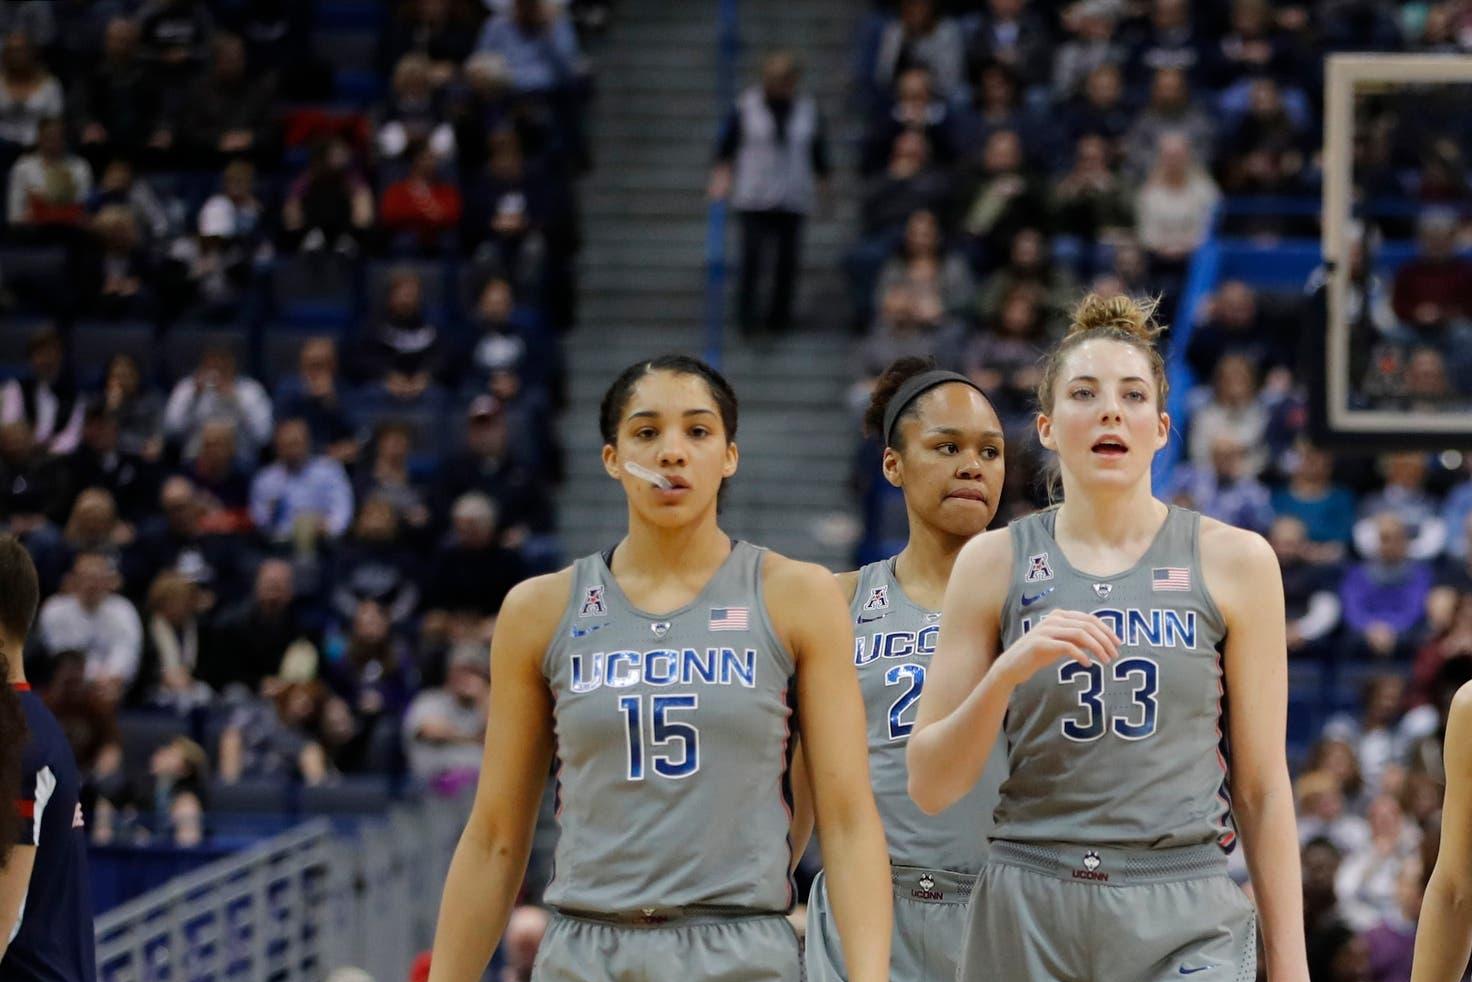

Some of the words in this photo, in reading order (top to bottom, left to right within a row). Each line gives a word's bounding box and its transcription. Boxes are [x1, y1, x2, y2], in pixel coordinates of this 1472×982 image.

[854, 625, 940, 666] UCO
[1022, 608, 1197, 651] ONN
[570, 648, 757, 693] UCONN
[885, 664, 926, 741] 2
[1058, 657, 1160, 742] 33
[618, 693, 701, 781] 15
[911, 888, 944, 901] UCONN
[1072, 869, 1109, 882] UCONN
